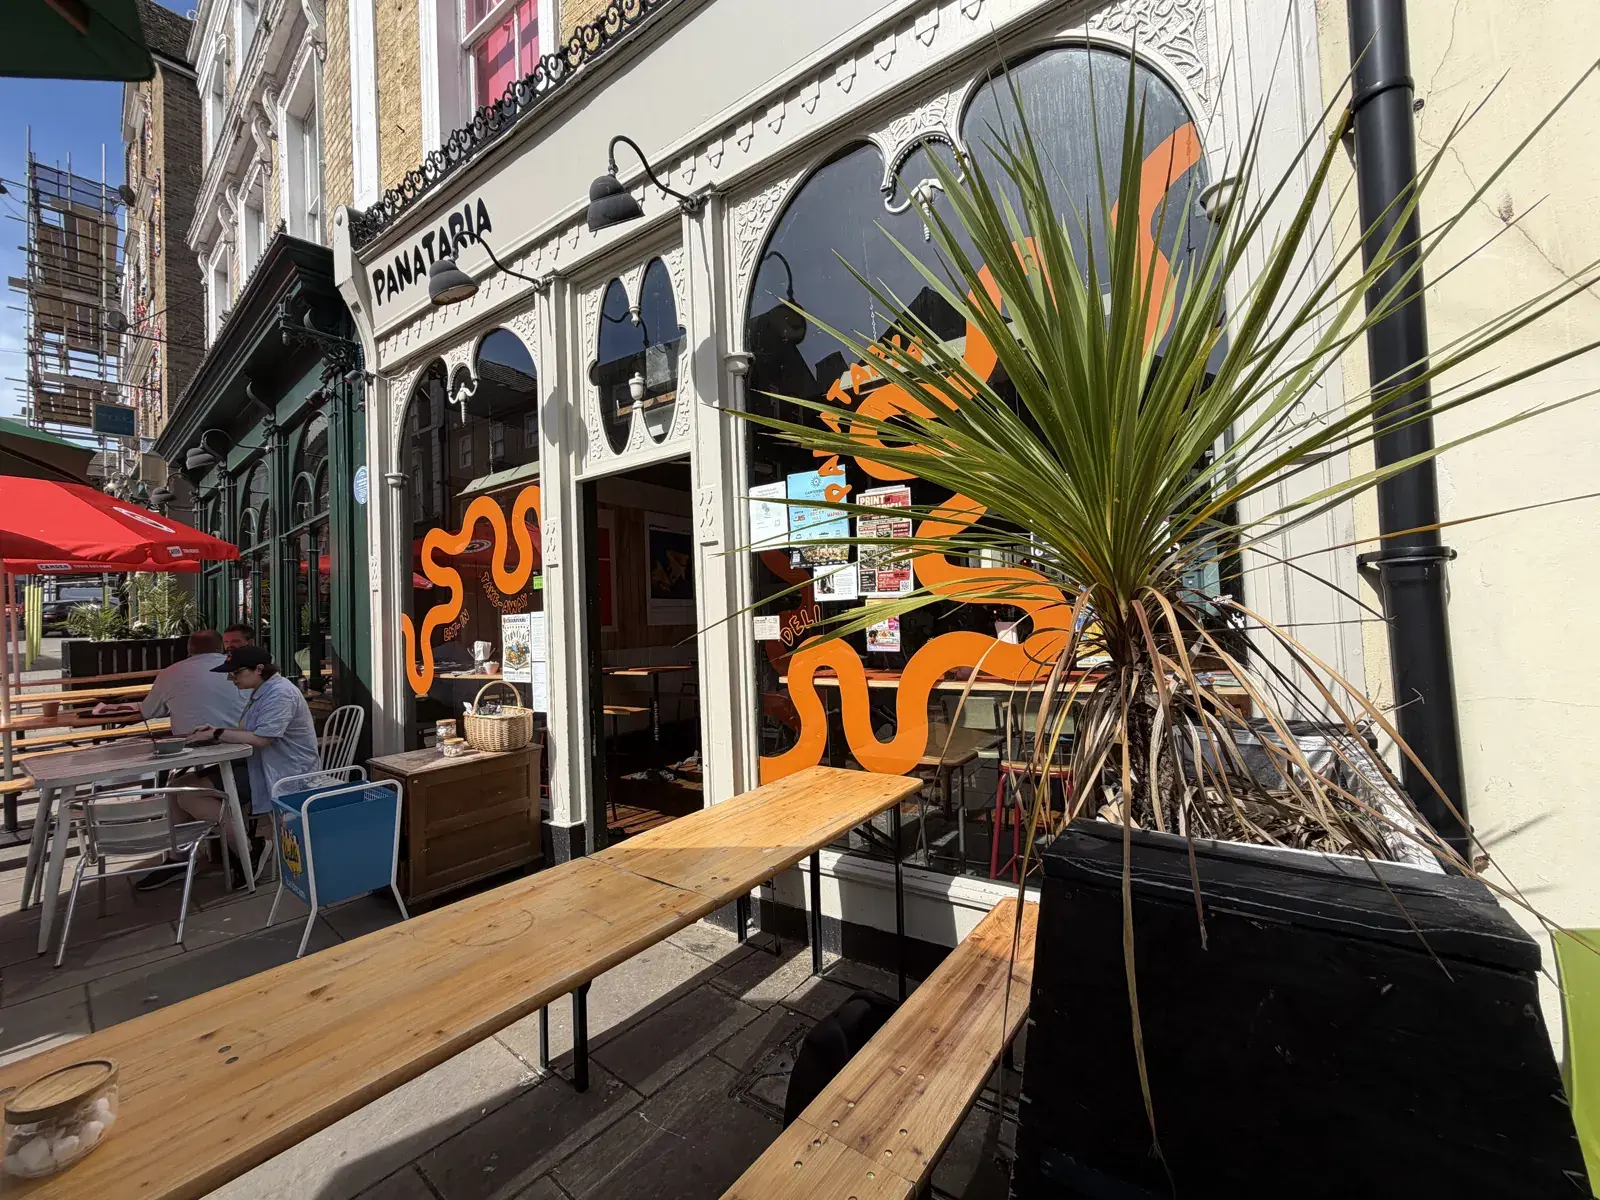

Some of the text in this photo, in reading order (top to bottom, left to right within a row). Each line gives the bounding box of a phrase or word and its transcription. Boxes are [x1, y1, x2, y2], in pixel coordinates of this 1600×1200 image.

[372, 197, 492, 306] PANATARIA
[860, 495, 885, 505] PRINT
[444, 608, 470, 642] EAT-IN
[780, 604, 820, 647] DELI
